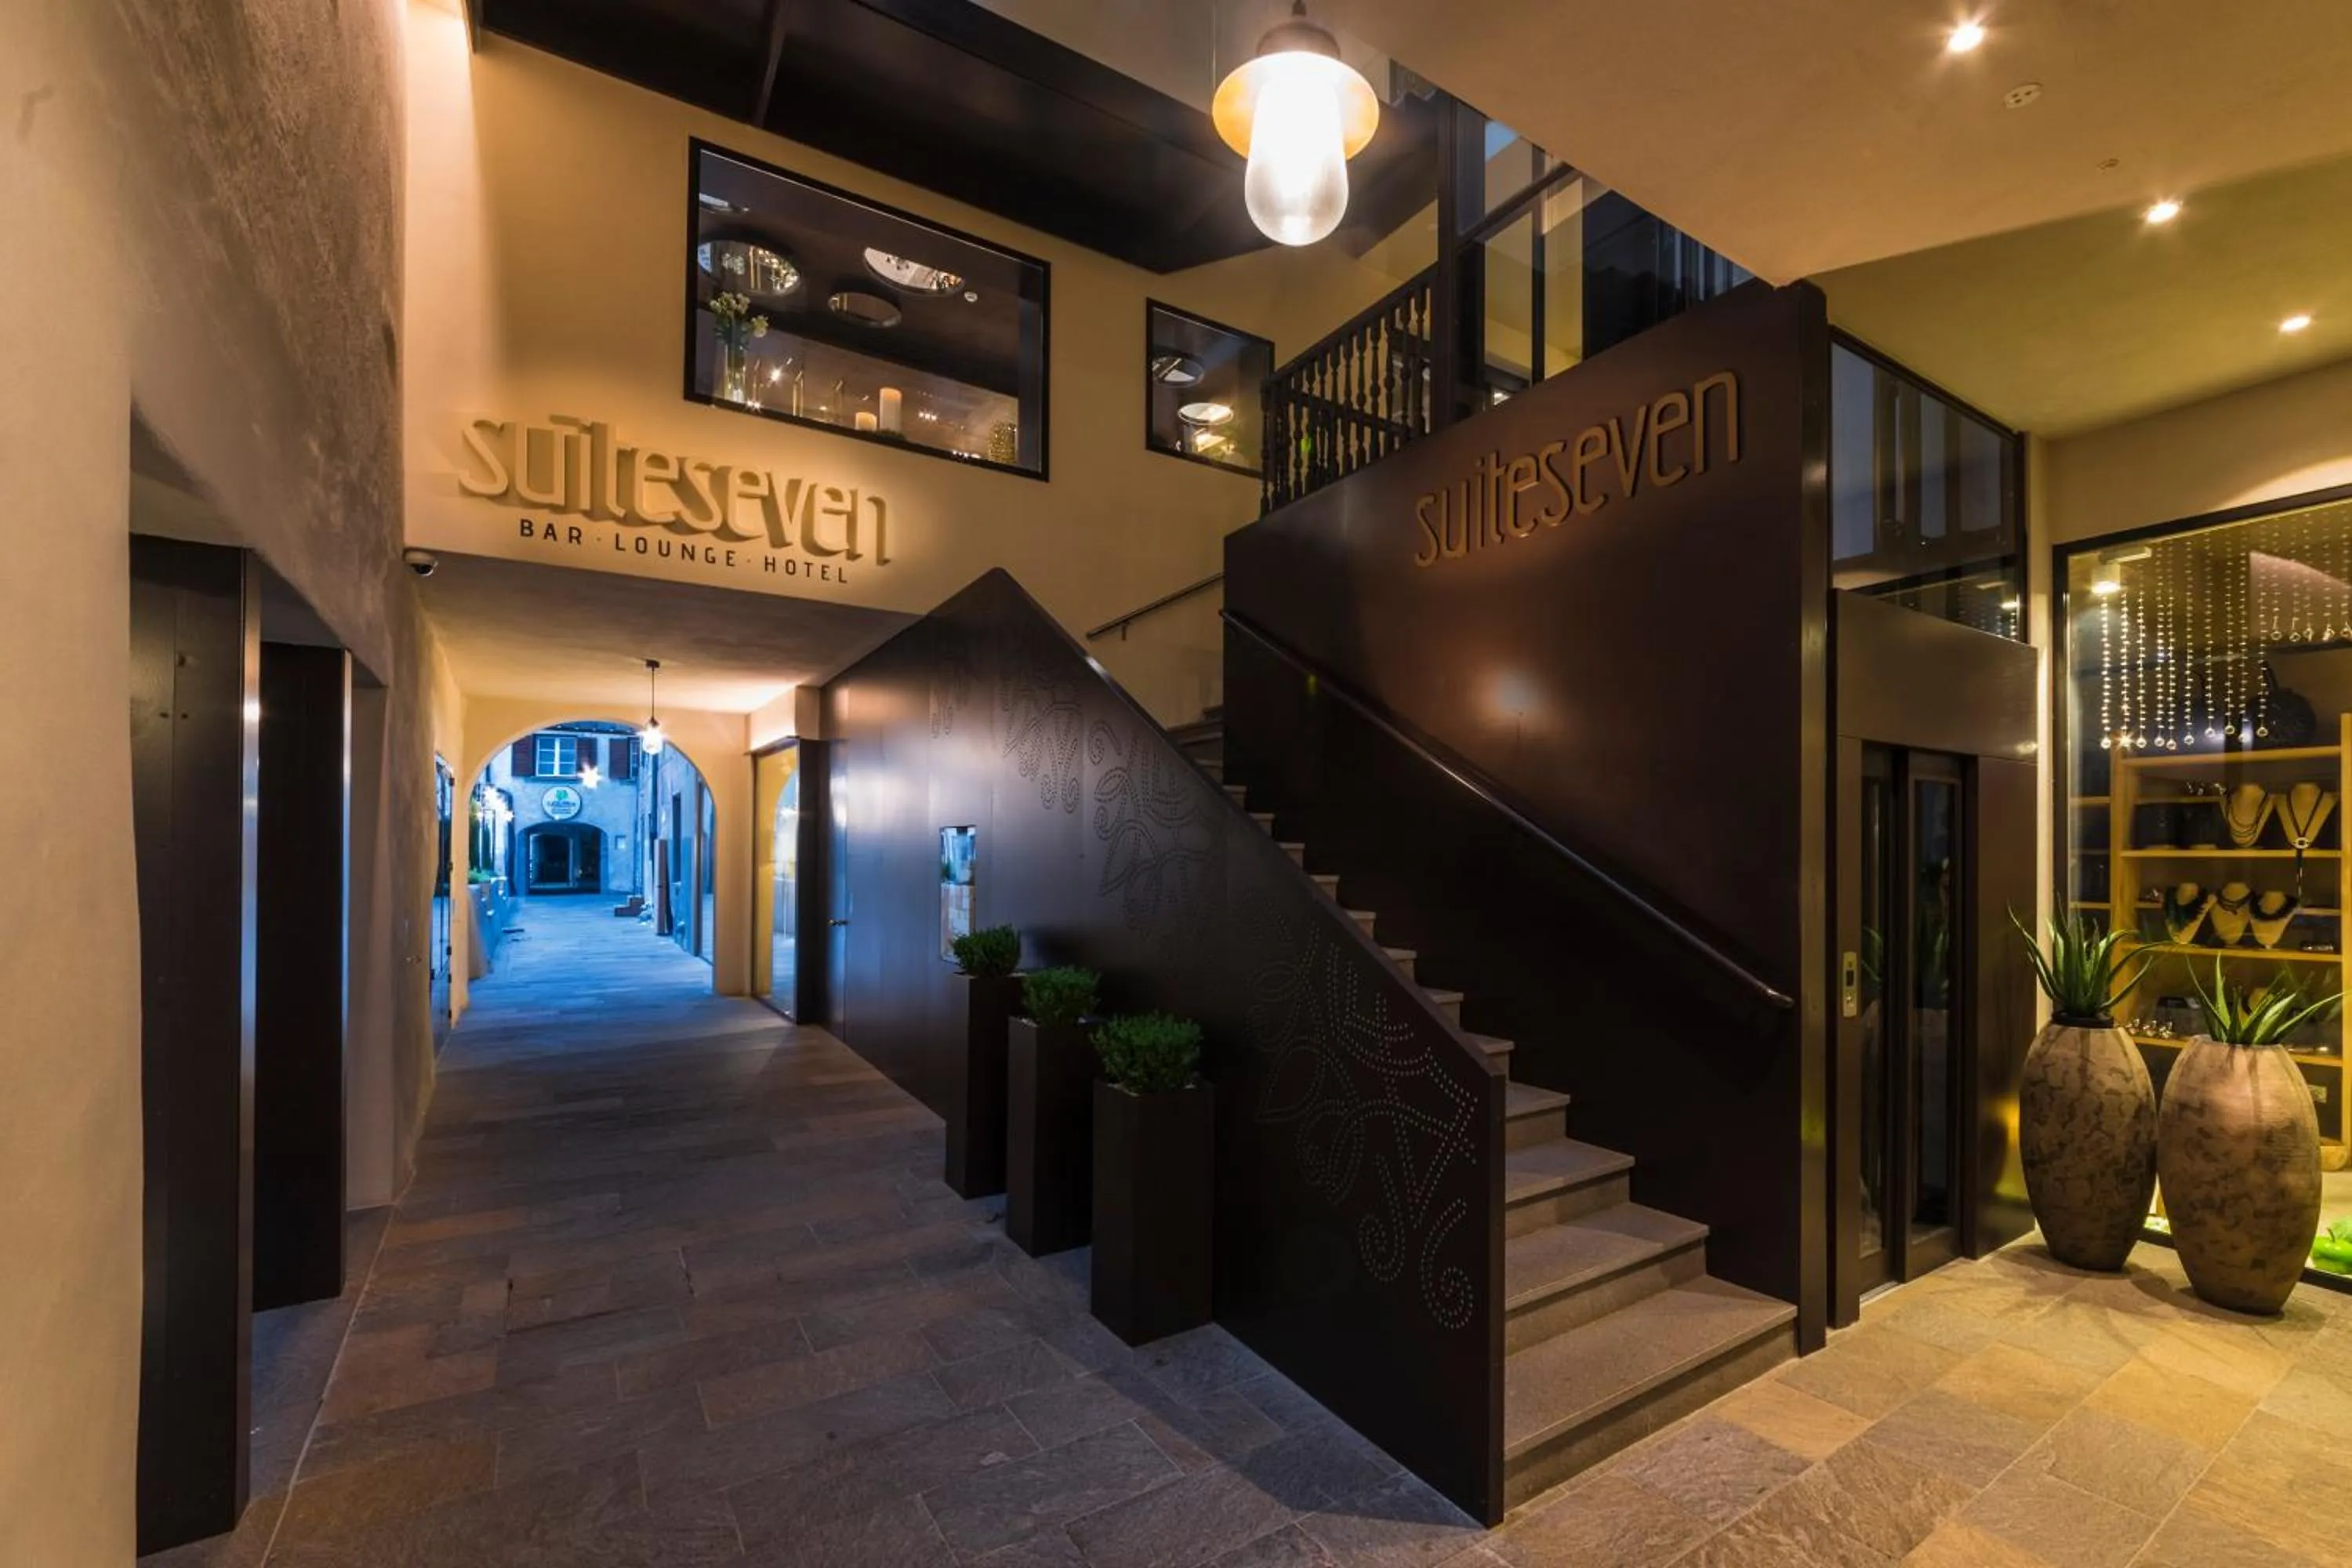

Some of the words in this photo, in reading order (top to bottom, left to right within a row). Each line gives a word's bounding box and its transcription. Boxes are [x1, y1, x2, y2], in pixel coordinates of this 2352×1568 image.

[459, 414, 891, 564] suiteseven
[1414, 370, 1740, 568] suiteseven
[519, 518, 583, 544] BAR
[614, 532, 737, 567] LOUNGE
[763, 556, 848, 583] HOTEL
